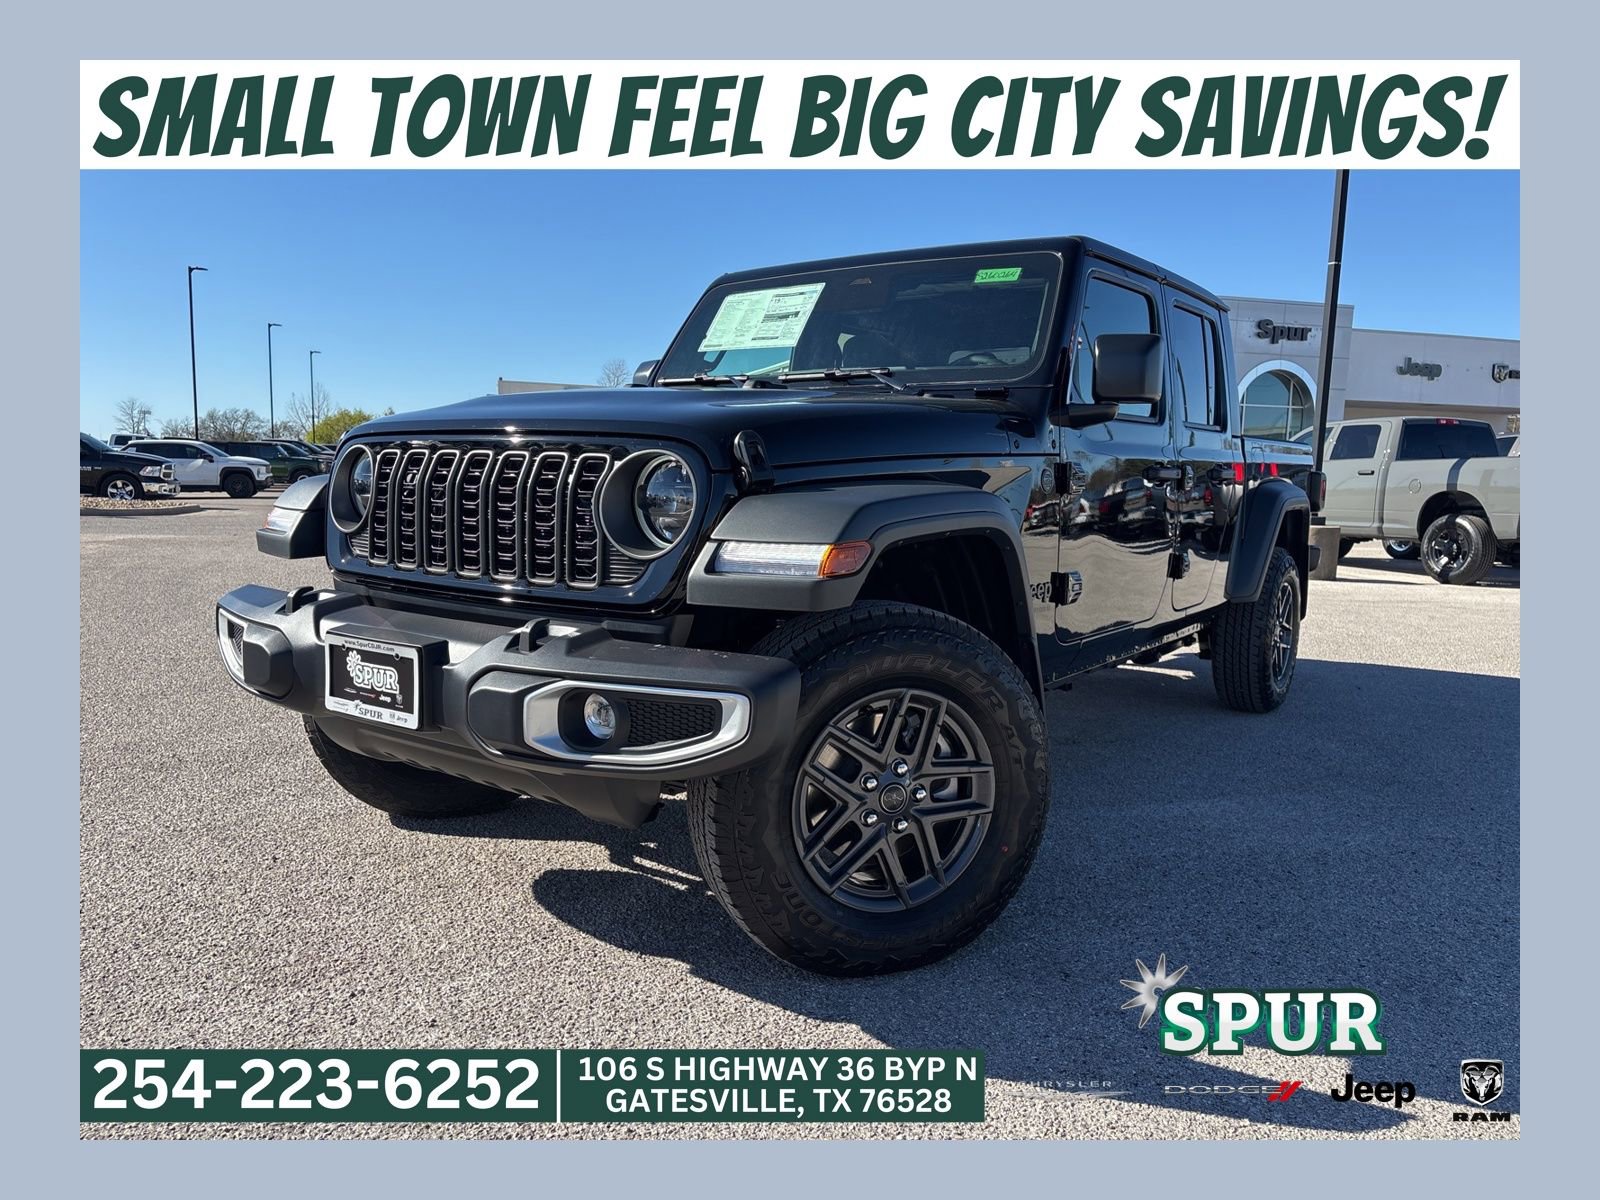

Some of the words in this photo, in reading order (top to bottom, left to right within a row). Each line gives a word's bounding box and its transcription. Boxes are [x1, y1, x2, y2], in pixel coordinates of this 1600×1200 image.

[1257, 319, 1312, 344] Spur
[1396, 357, 1442, 381] Jeep
[1029, 581, 1052, 603] eep
[354, 664, 398, 693] SPUR
[359, 707, 383, 720] SPUR
